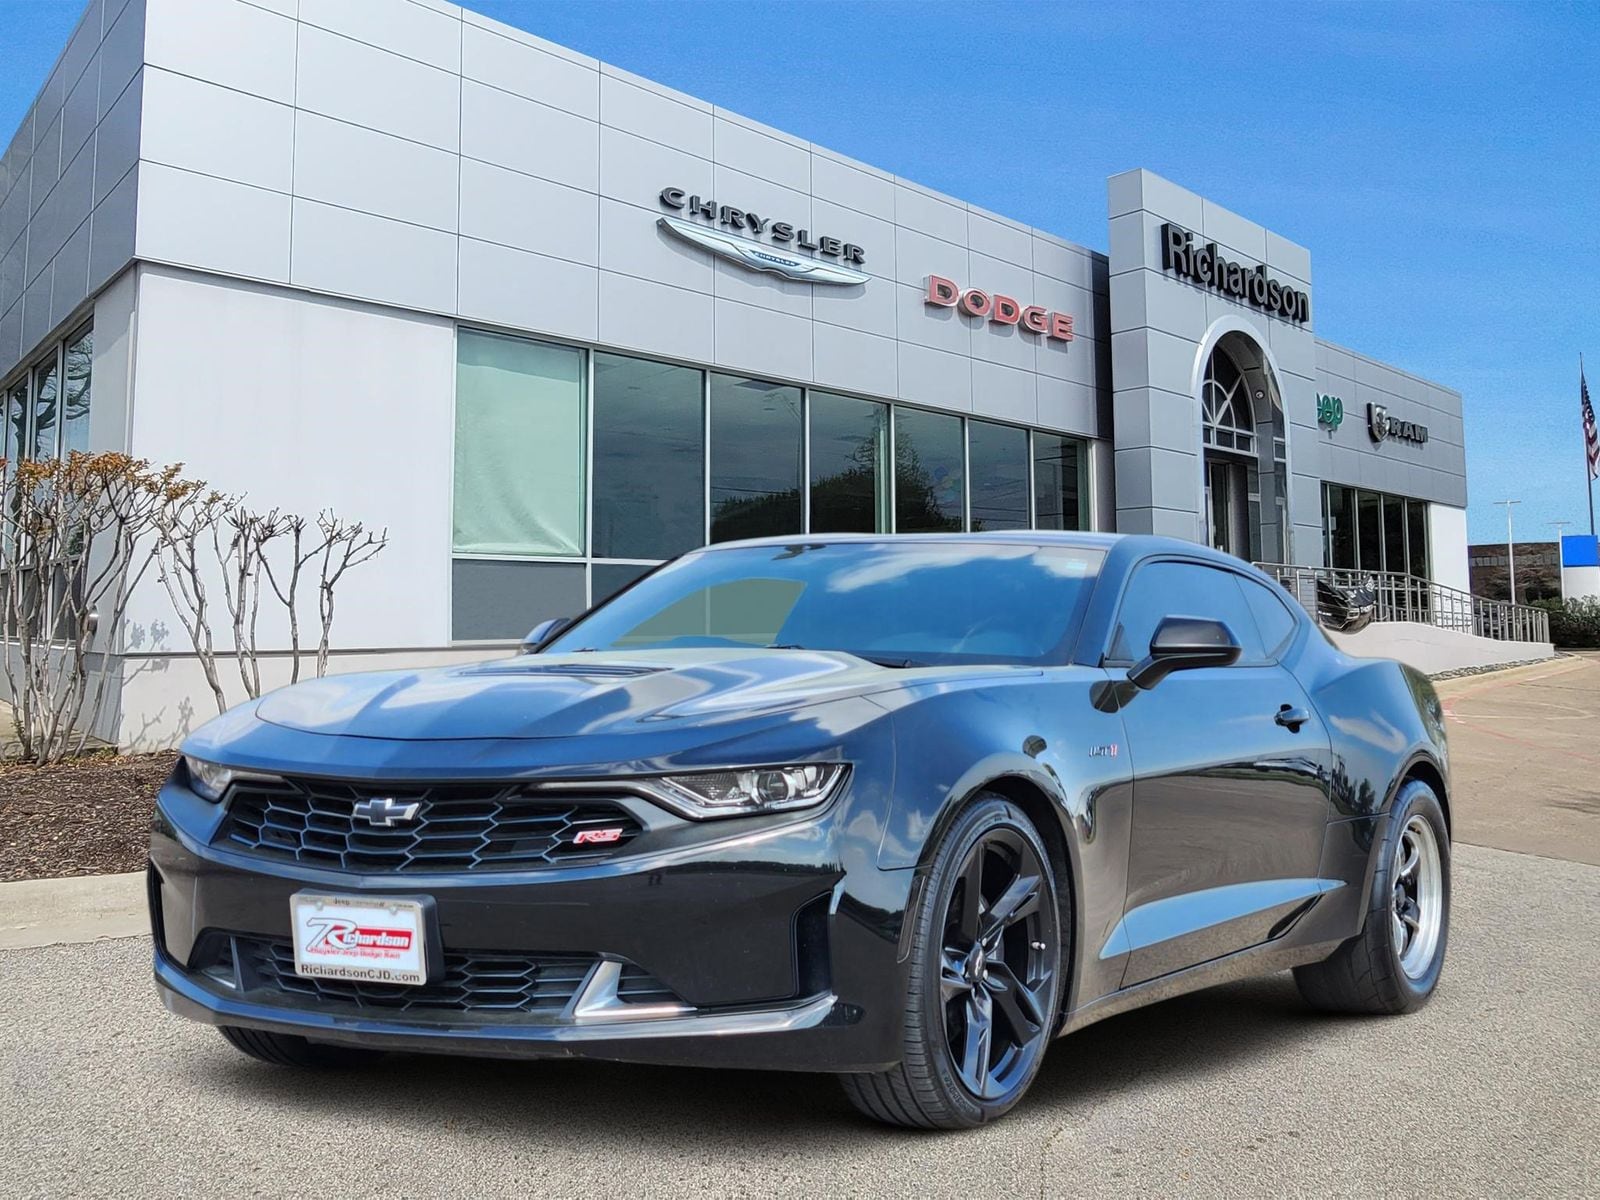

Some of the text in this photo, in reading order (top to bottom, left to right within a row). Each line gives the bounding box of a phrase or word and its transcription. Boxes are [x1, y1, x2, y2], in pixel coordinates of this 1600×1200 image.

[660, 187, 866, 264] CHRYSLER
[1161, 223, 1310, 324] Richardson
[924, 274, 1074, 342] DODGE
[1389, 416, 1429, 443] RAM
[573, 828, 623, 844] RS
[306, 917, 411, 951] Richardson
[301, 964, 420, 982] RichardsonCJD.com
